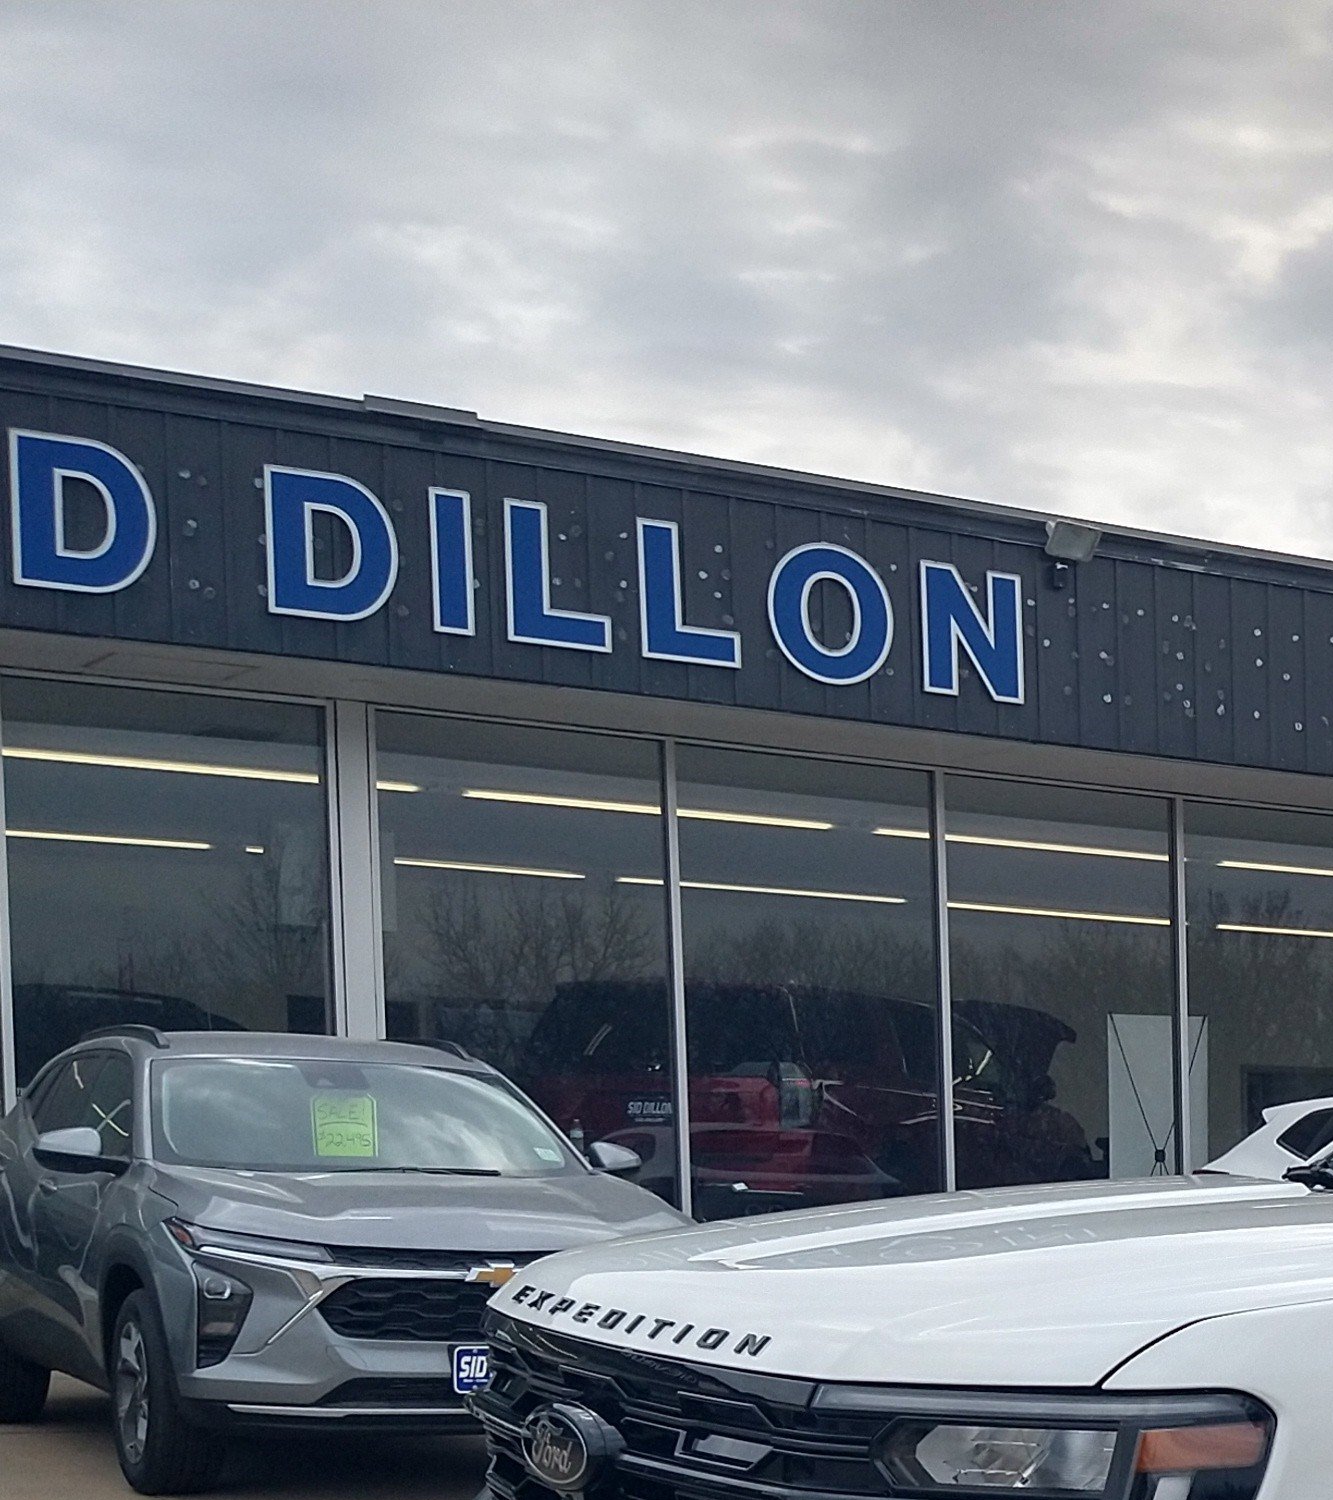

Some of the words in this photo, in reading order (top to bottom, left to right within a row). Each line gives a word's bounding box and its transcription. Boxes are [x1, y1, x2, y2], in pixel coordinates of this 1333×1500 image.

[8, 427, 157, 594] D
[263, 463, 1024, 705] DILLON
[627, 1101, 643, 1114] SID
[511, 1284, 772, 1357] EXPEDITION
[459, 1355, 488, 1378] SID
